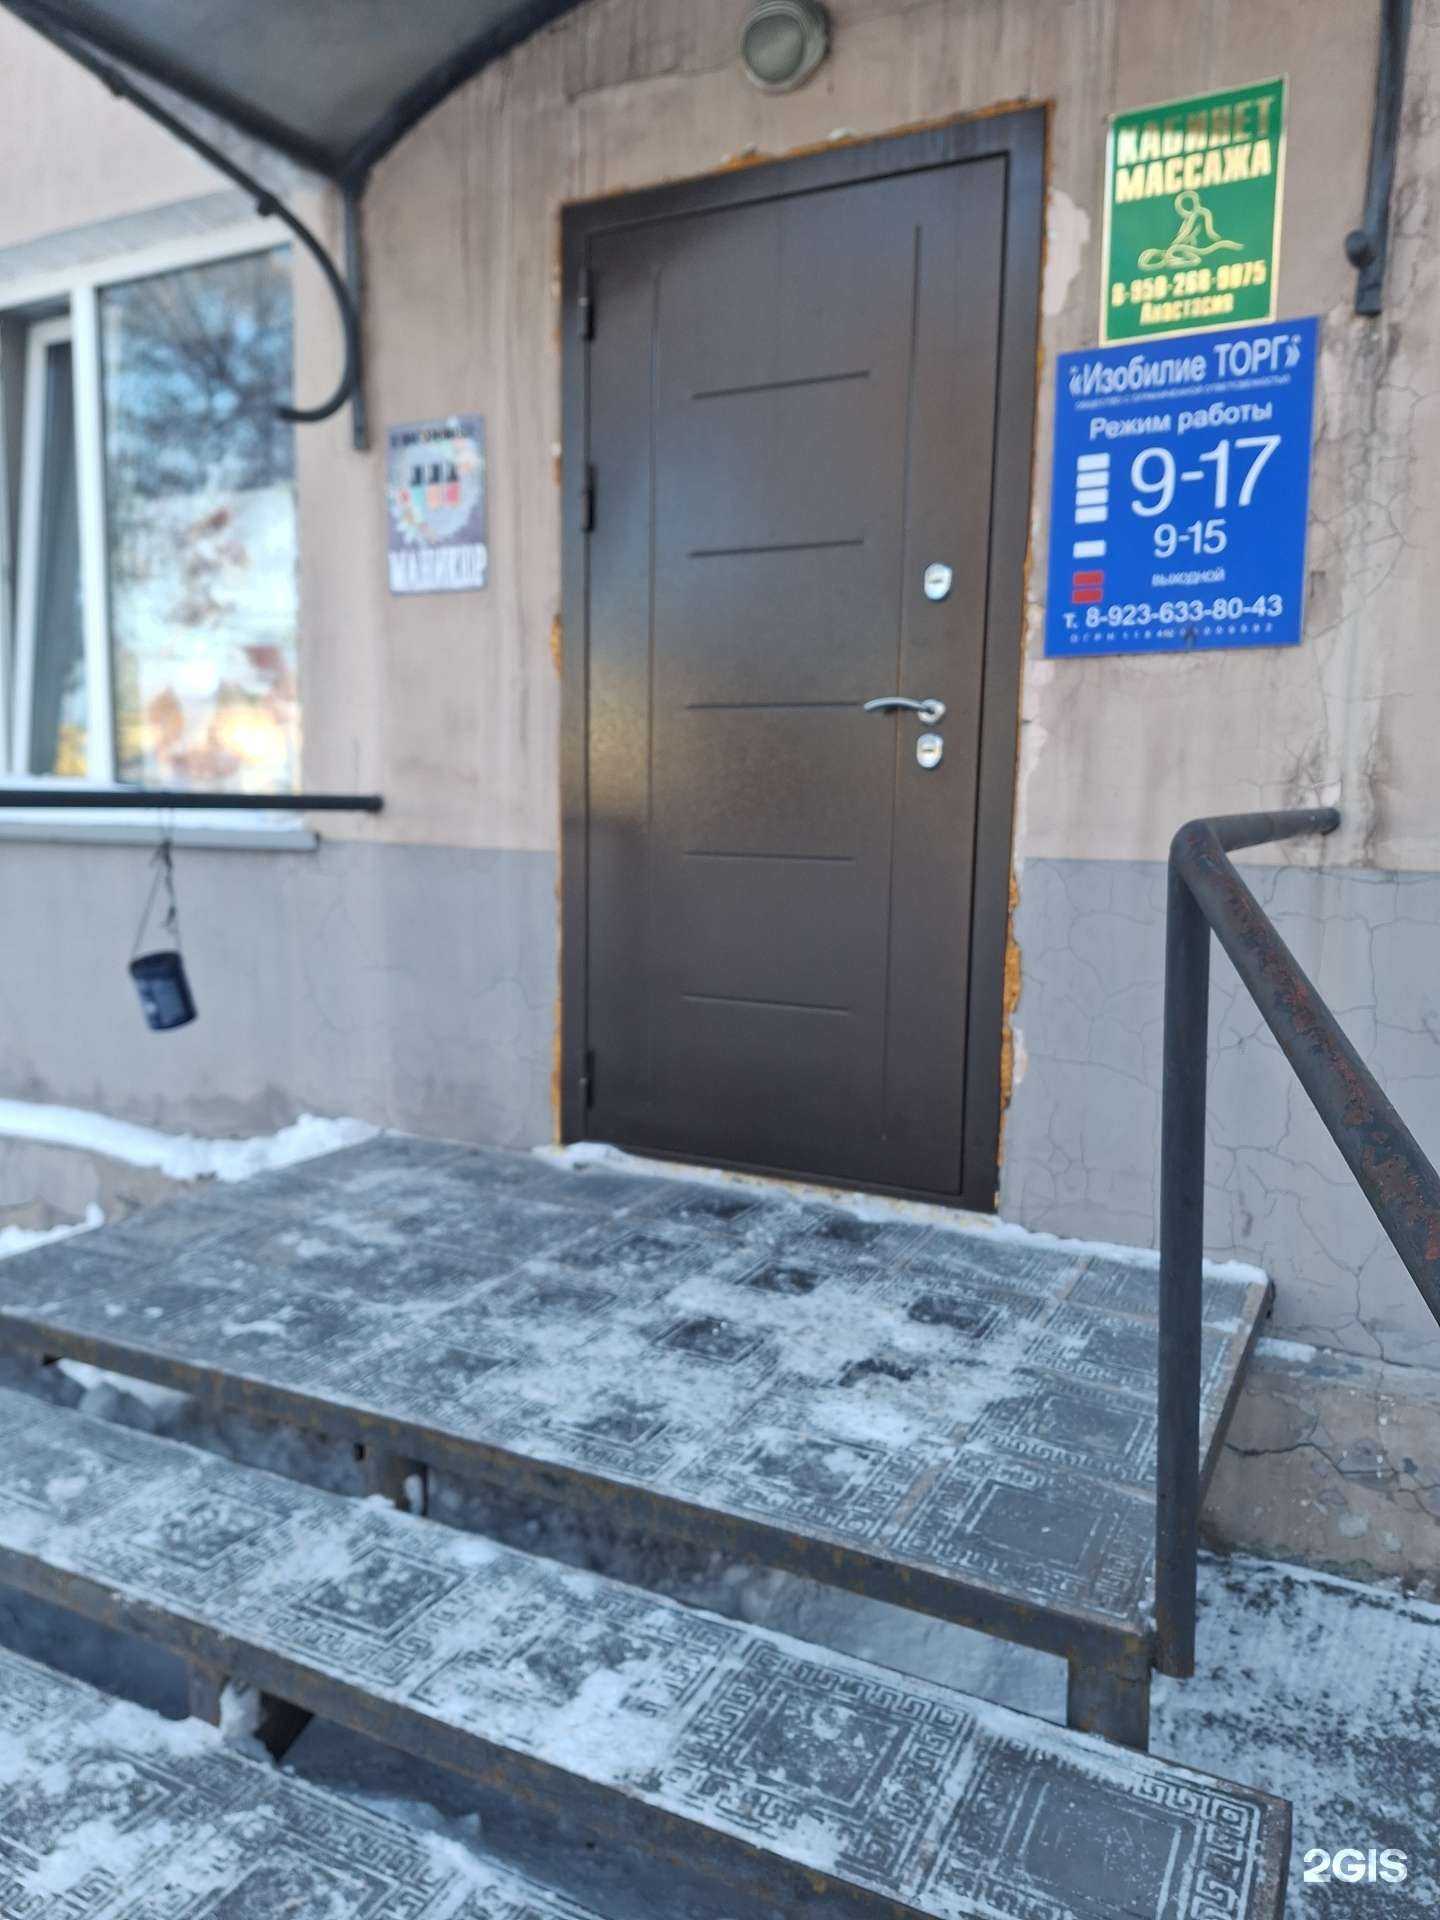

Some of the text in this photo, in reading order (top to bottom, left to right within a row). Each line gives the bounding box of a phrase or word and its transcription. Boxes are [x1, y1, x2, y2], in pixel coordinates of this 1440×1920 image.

[1117, 96, 1275, 168] КАБИНЕТ
[1114, 138, 1272, 204] МАССАЖА
[1089, 401, 1273, 441] Режим работы
[1130, 434, 1281, 517] 9-17
[1154, 519, 1227, 558] 9-15
[1085, 594, 1283, 628] 8-923-633-80-43
